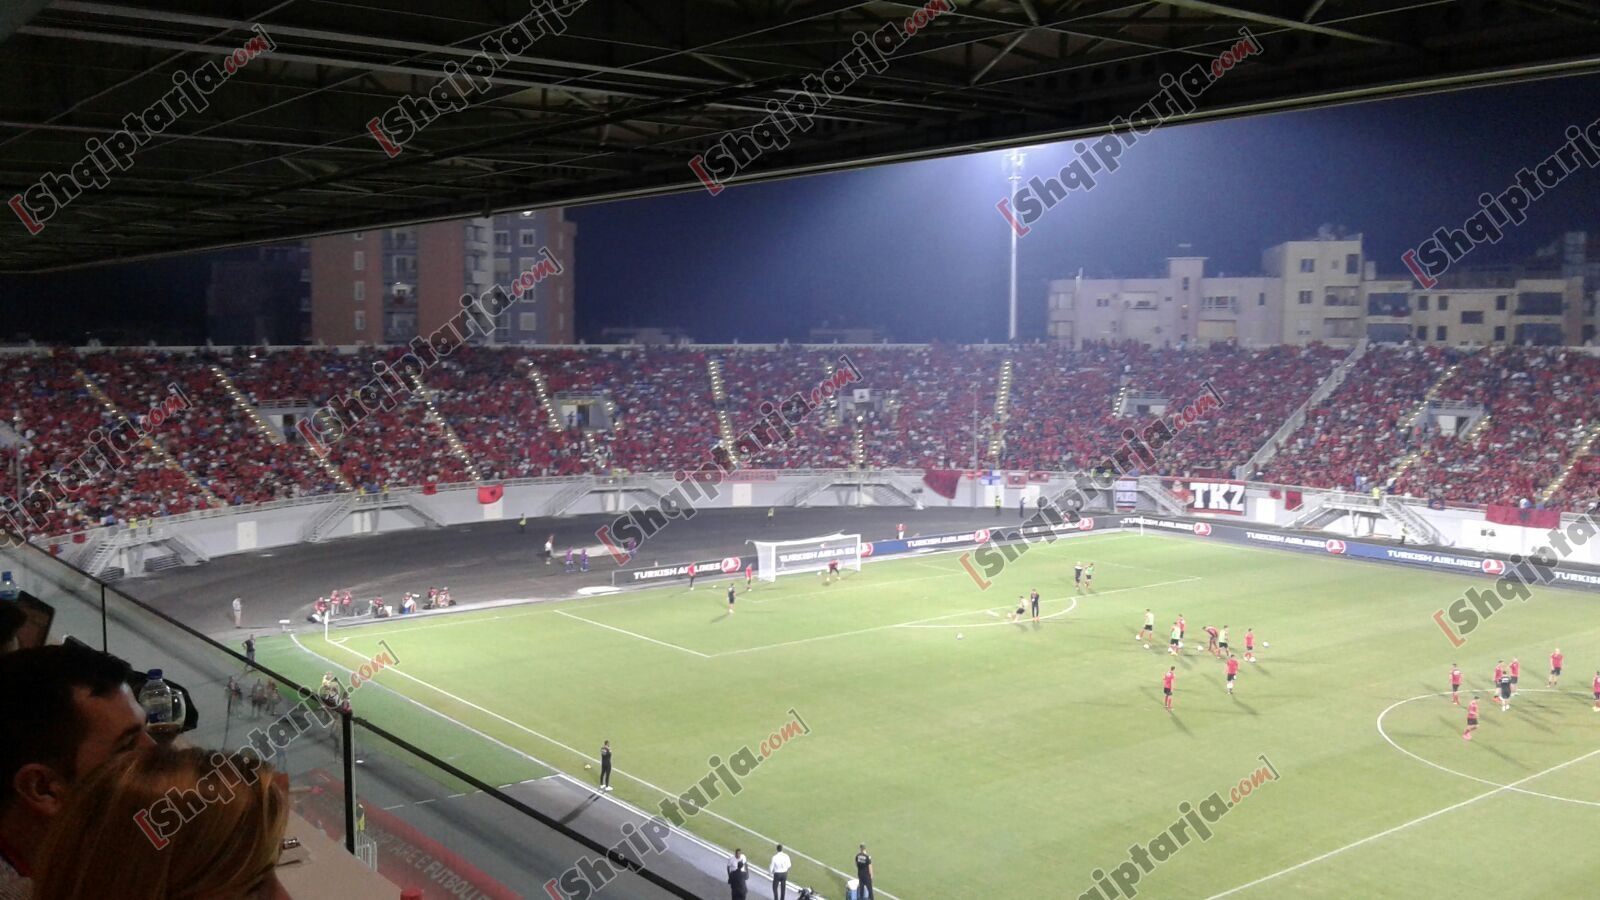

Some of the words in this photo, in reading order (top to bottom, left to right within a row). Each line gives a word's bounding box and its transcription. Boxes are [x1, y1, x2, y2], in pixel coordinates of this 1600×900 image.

[1189, 482, 1245, 511] TKZ
[1246, 532, 1284, 543] TURKISH
[1284, 537, 1326, 548] AIRLINES
[1387, 549, 1432, 563] TURKISH
[1432, 555, 1481, 569] AIRLINES
[633, 567, 677, 580] TURKISH
[677, 562, 722, 575] AILINES
